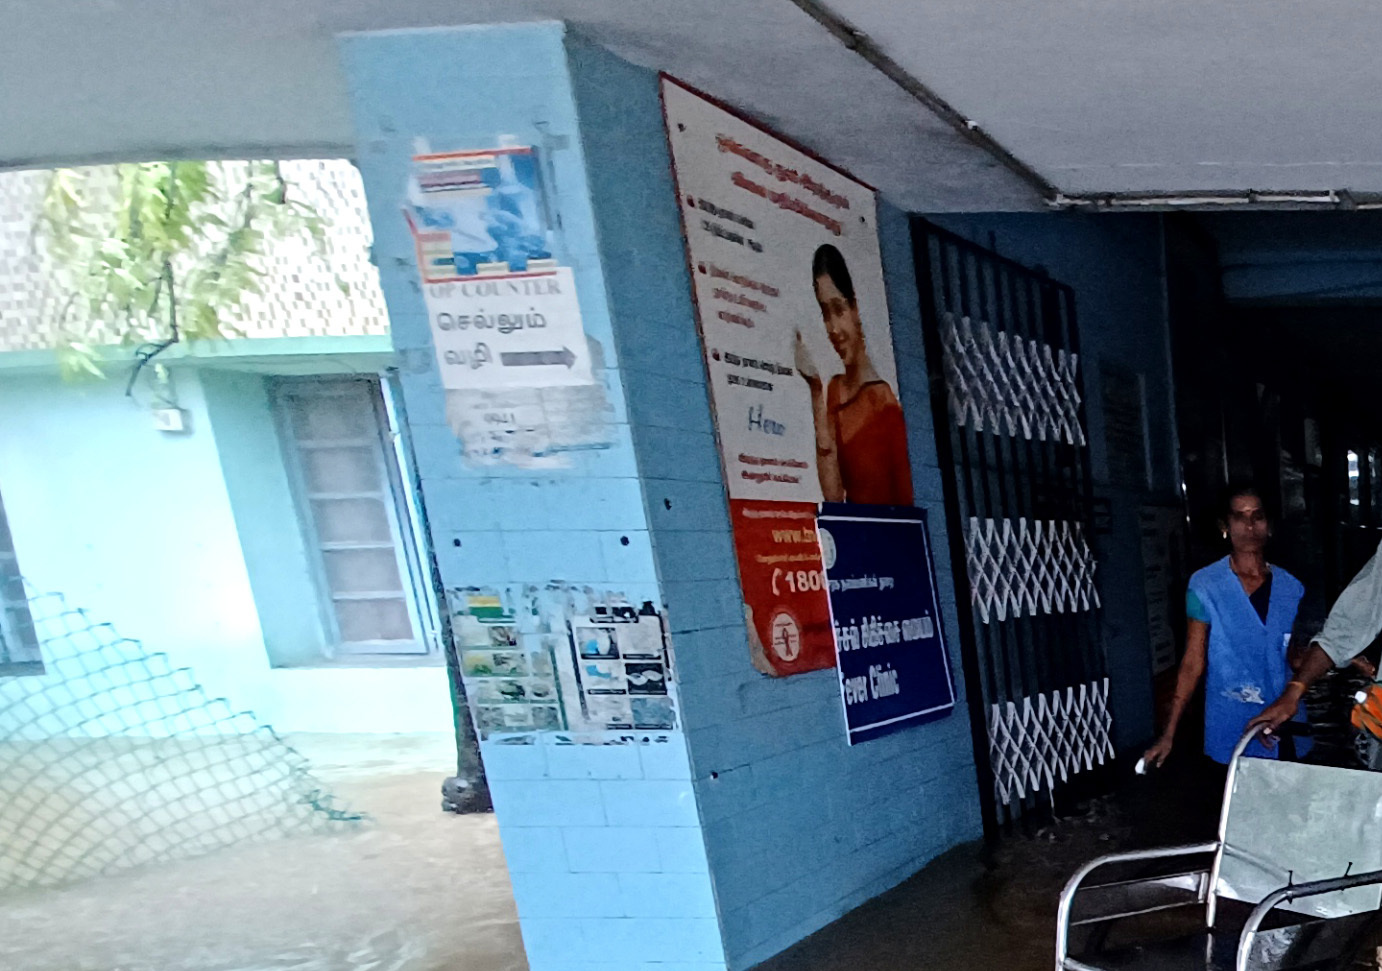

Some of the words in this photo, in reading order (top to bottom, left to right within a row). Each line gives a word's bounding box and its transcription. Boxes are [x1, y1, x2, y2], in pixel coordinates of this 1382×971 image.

[437, 306, 547, 334] செல்லும்
[444, 342, 493, 370] வழி
[842, 672, 868, 705] ever
